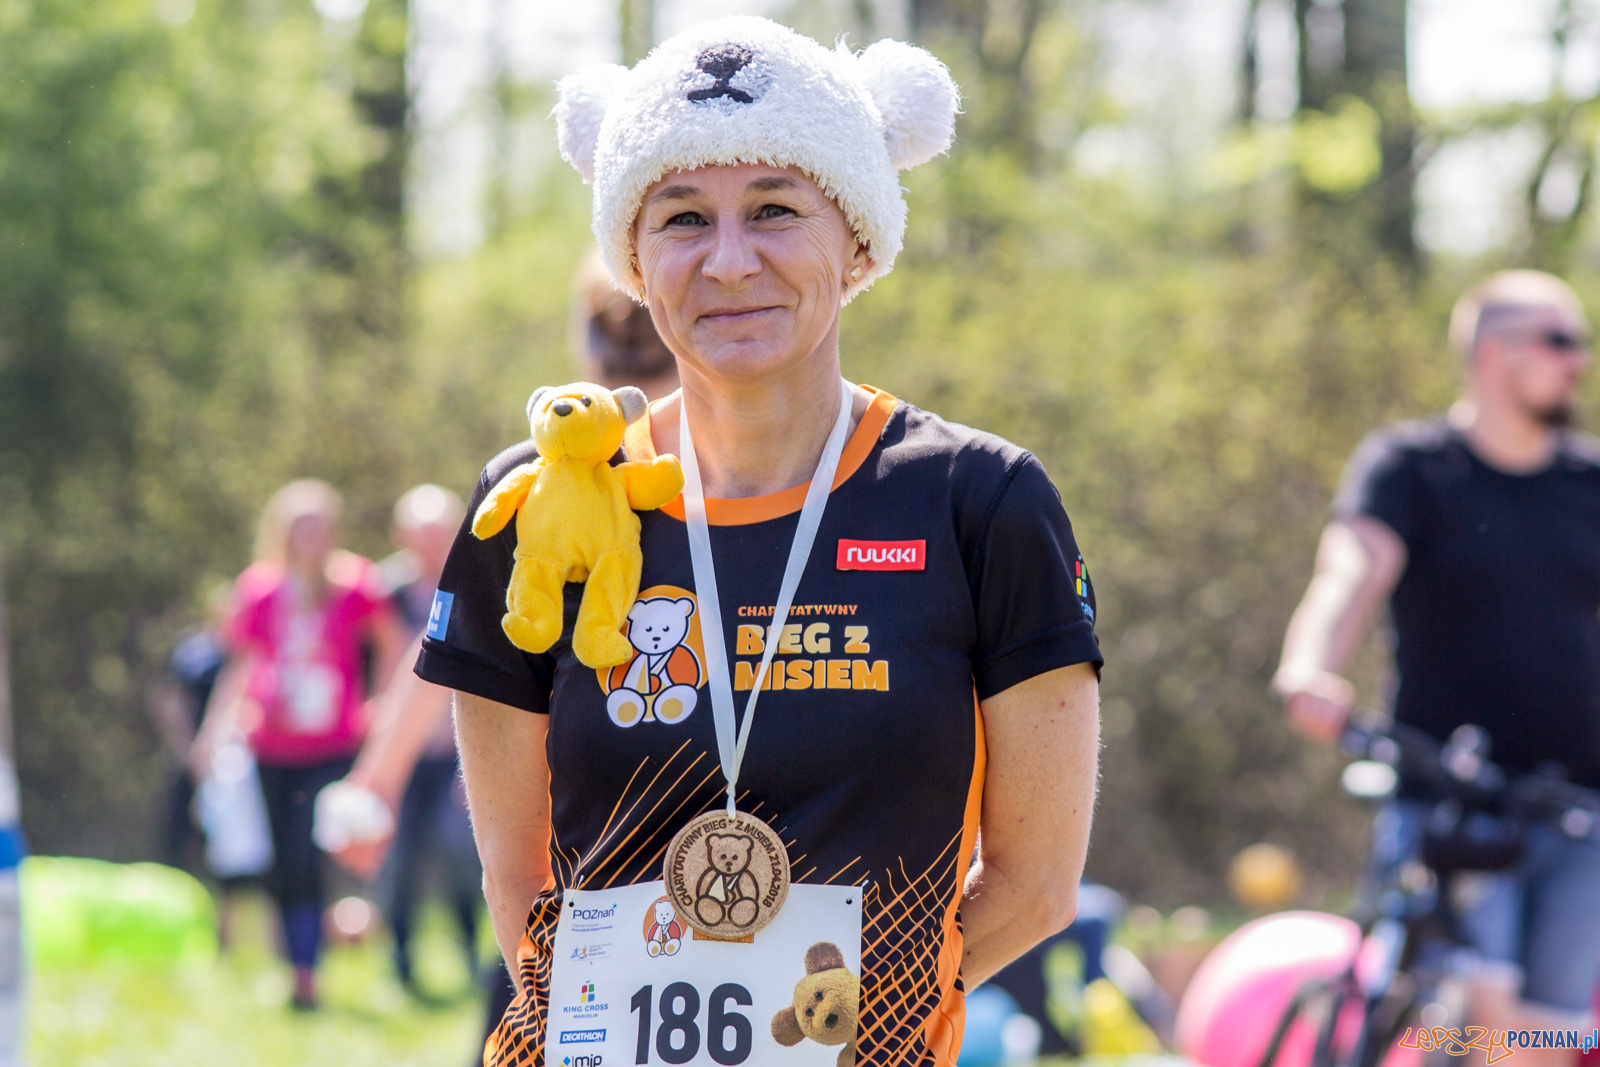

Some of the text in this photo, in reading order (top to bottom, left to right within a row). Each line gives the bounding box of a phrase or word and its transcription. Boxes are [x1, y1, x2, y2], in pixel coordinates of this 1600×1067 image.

[737, 604, 858, 617] CHARTATYWNY
[734, 659, 890, 692] MISIEM
[672, 818, 783, 908] CHARYTATYWNY BIEG Z MISIEM 21.04.2018
[584, 1003, 609, 1012] CROSS
[630, 981, 753, 1067] 186
[562, 1031, 604, 1042] DECATHLON
